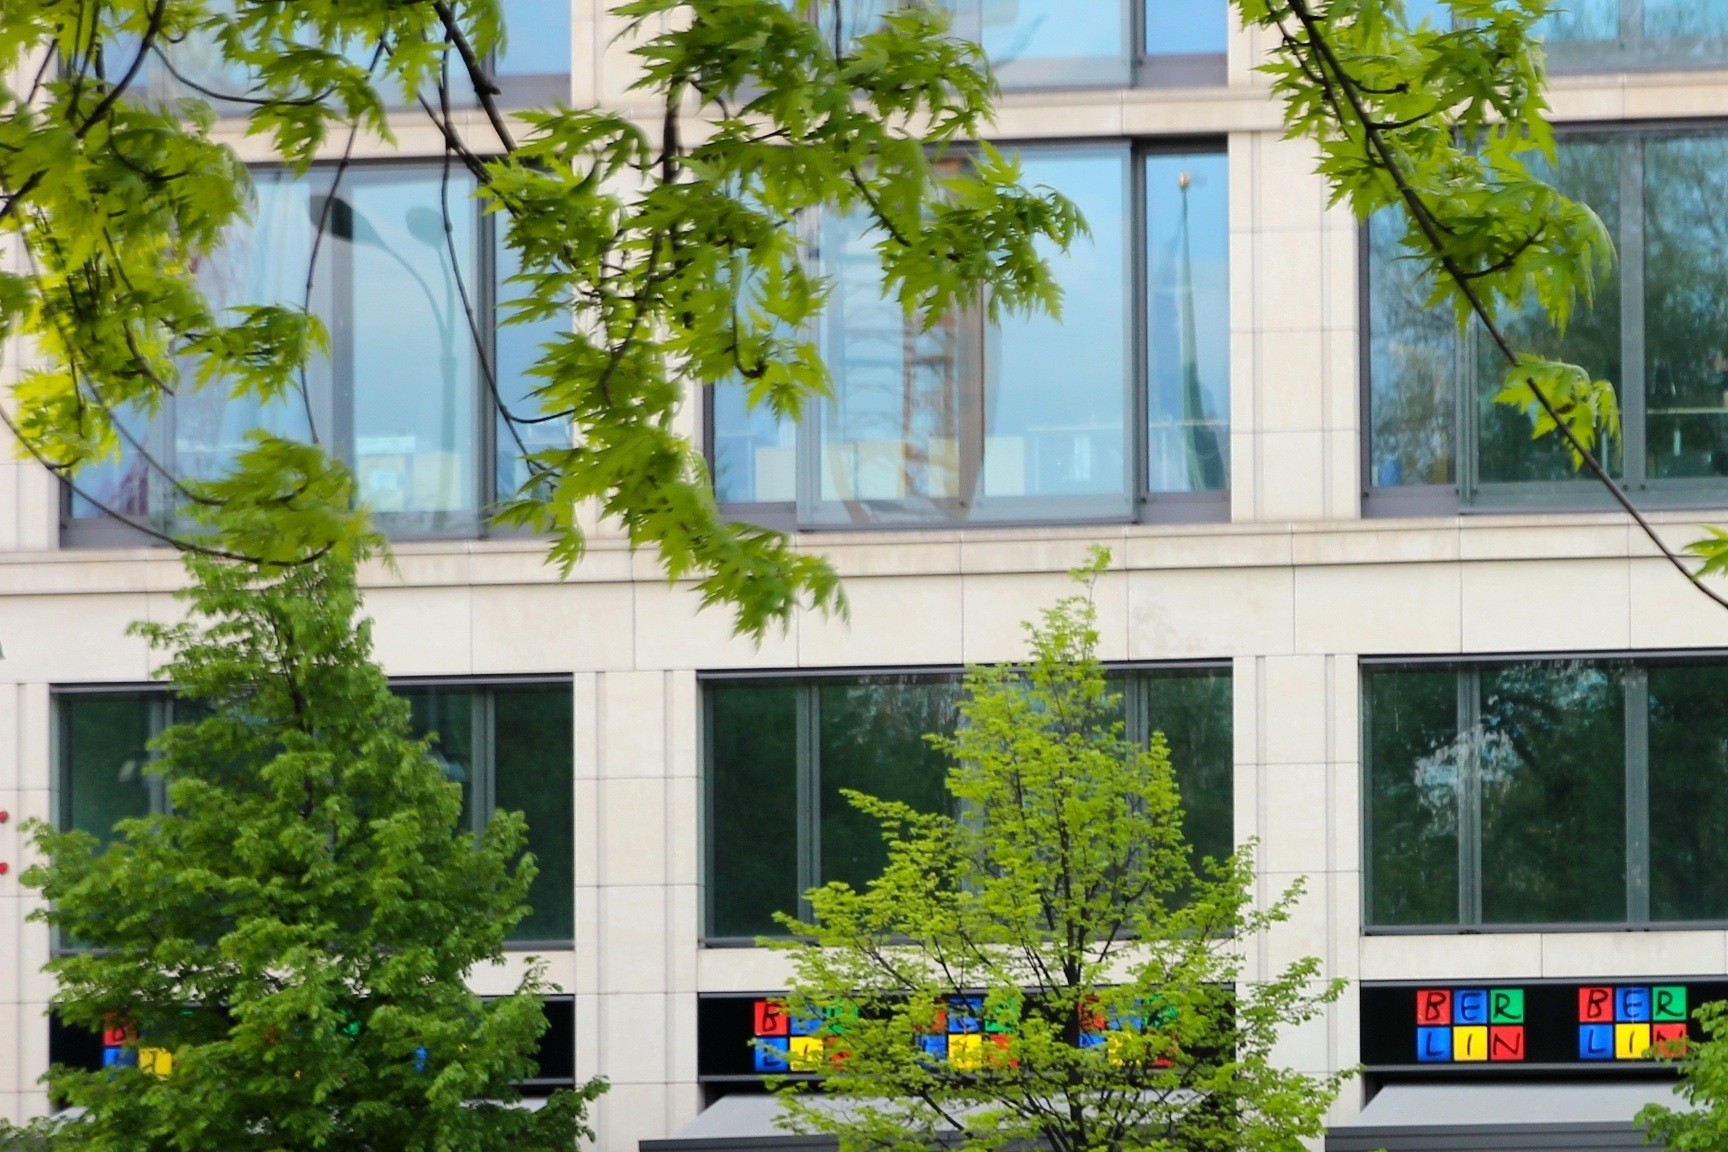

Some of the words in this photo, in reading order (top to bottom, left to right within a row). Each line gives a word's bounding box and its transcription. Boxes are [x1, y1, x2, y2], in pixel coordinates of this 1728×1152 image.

[1425, 991, 1522, 1021] BER
[1587, 988, 1685, 1018] BER
[1425, 1031, 1521, 1056] LIN
